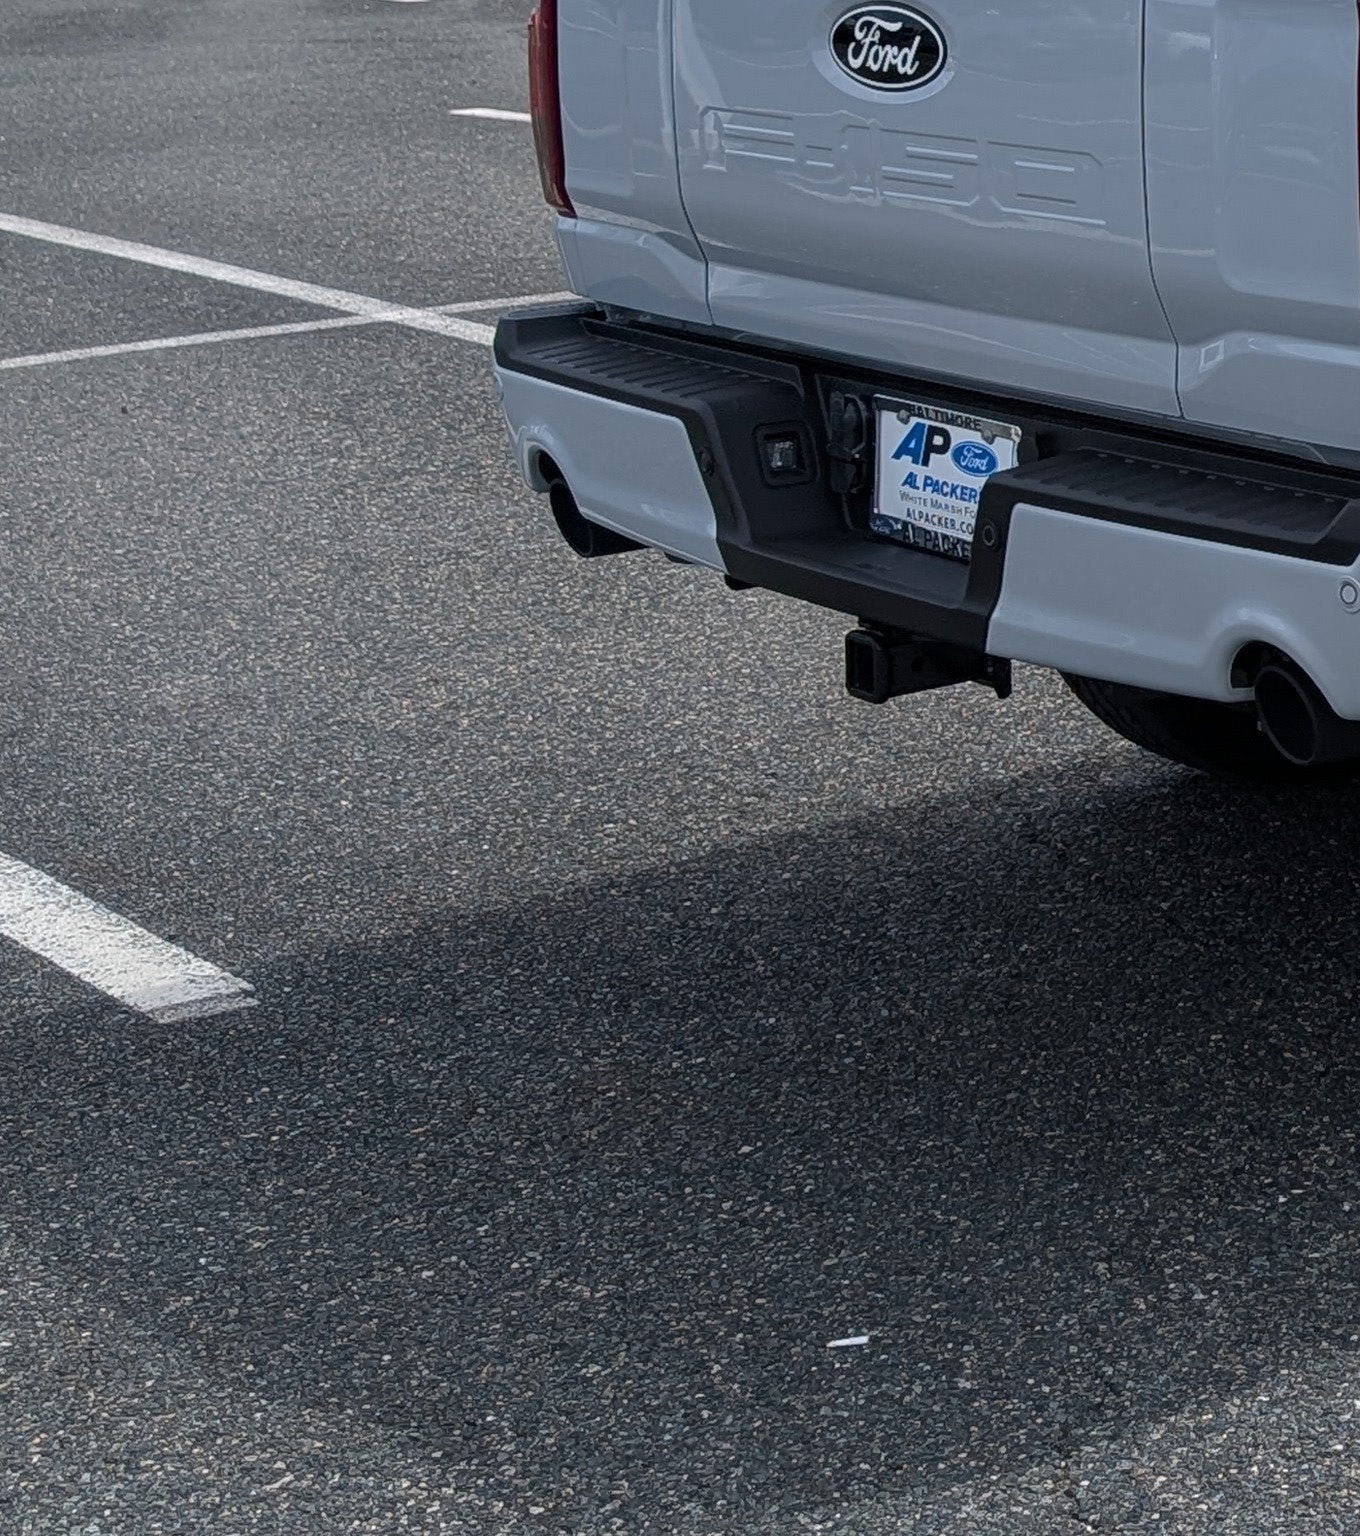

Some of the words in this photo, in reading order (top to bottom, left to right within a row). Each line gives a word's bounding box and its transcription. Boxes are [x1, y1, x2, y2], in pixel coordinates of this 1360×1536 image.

[847, 15, 922, 76] Ford
[908, 404, 982, 431] BALTIMORE
[891, 421, 951, 467] AP
[960, 445, 989, 471] Ford
[901, 471, 920, 491] AL
[906, 507, 974, 535] ALPACKER.CO
[924, 526, 972, 560] PACKE
